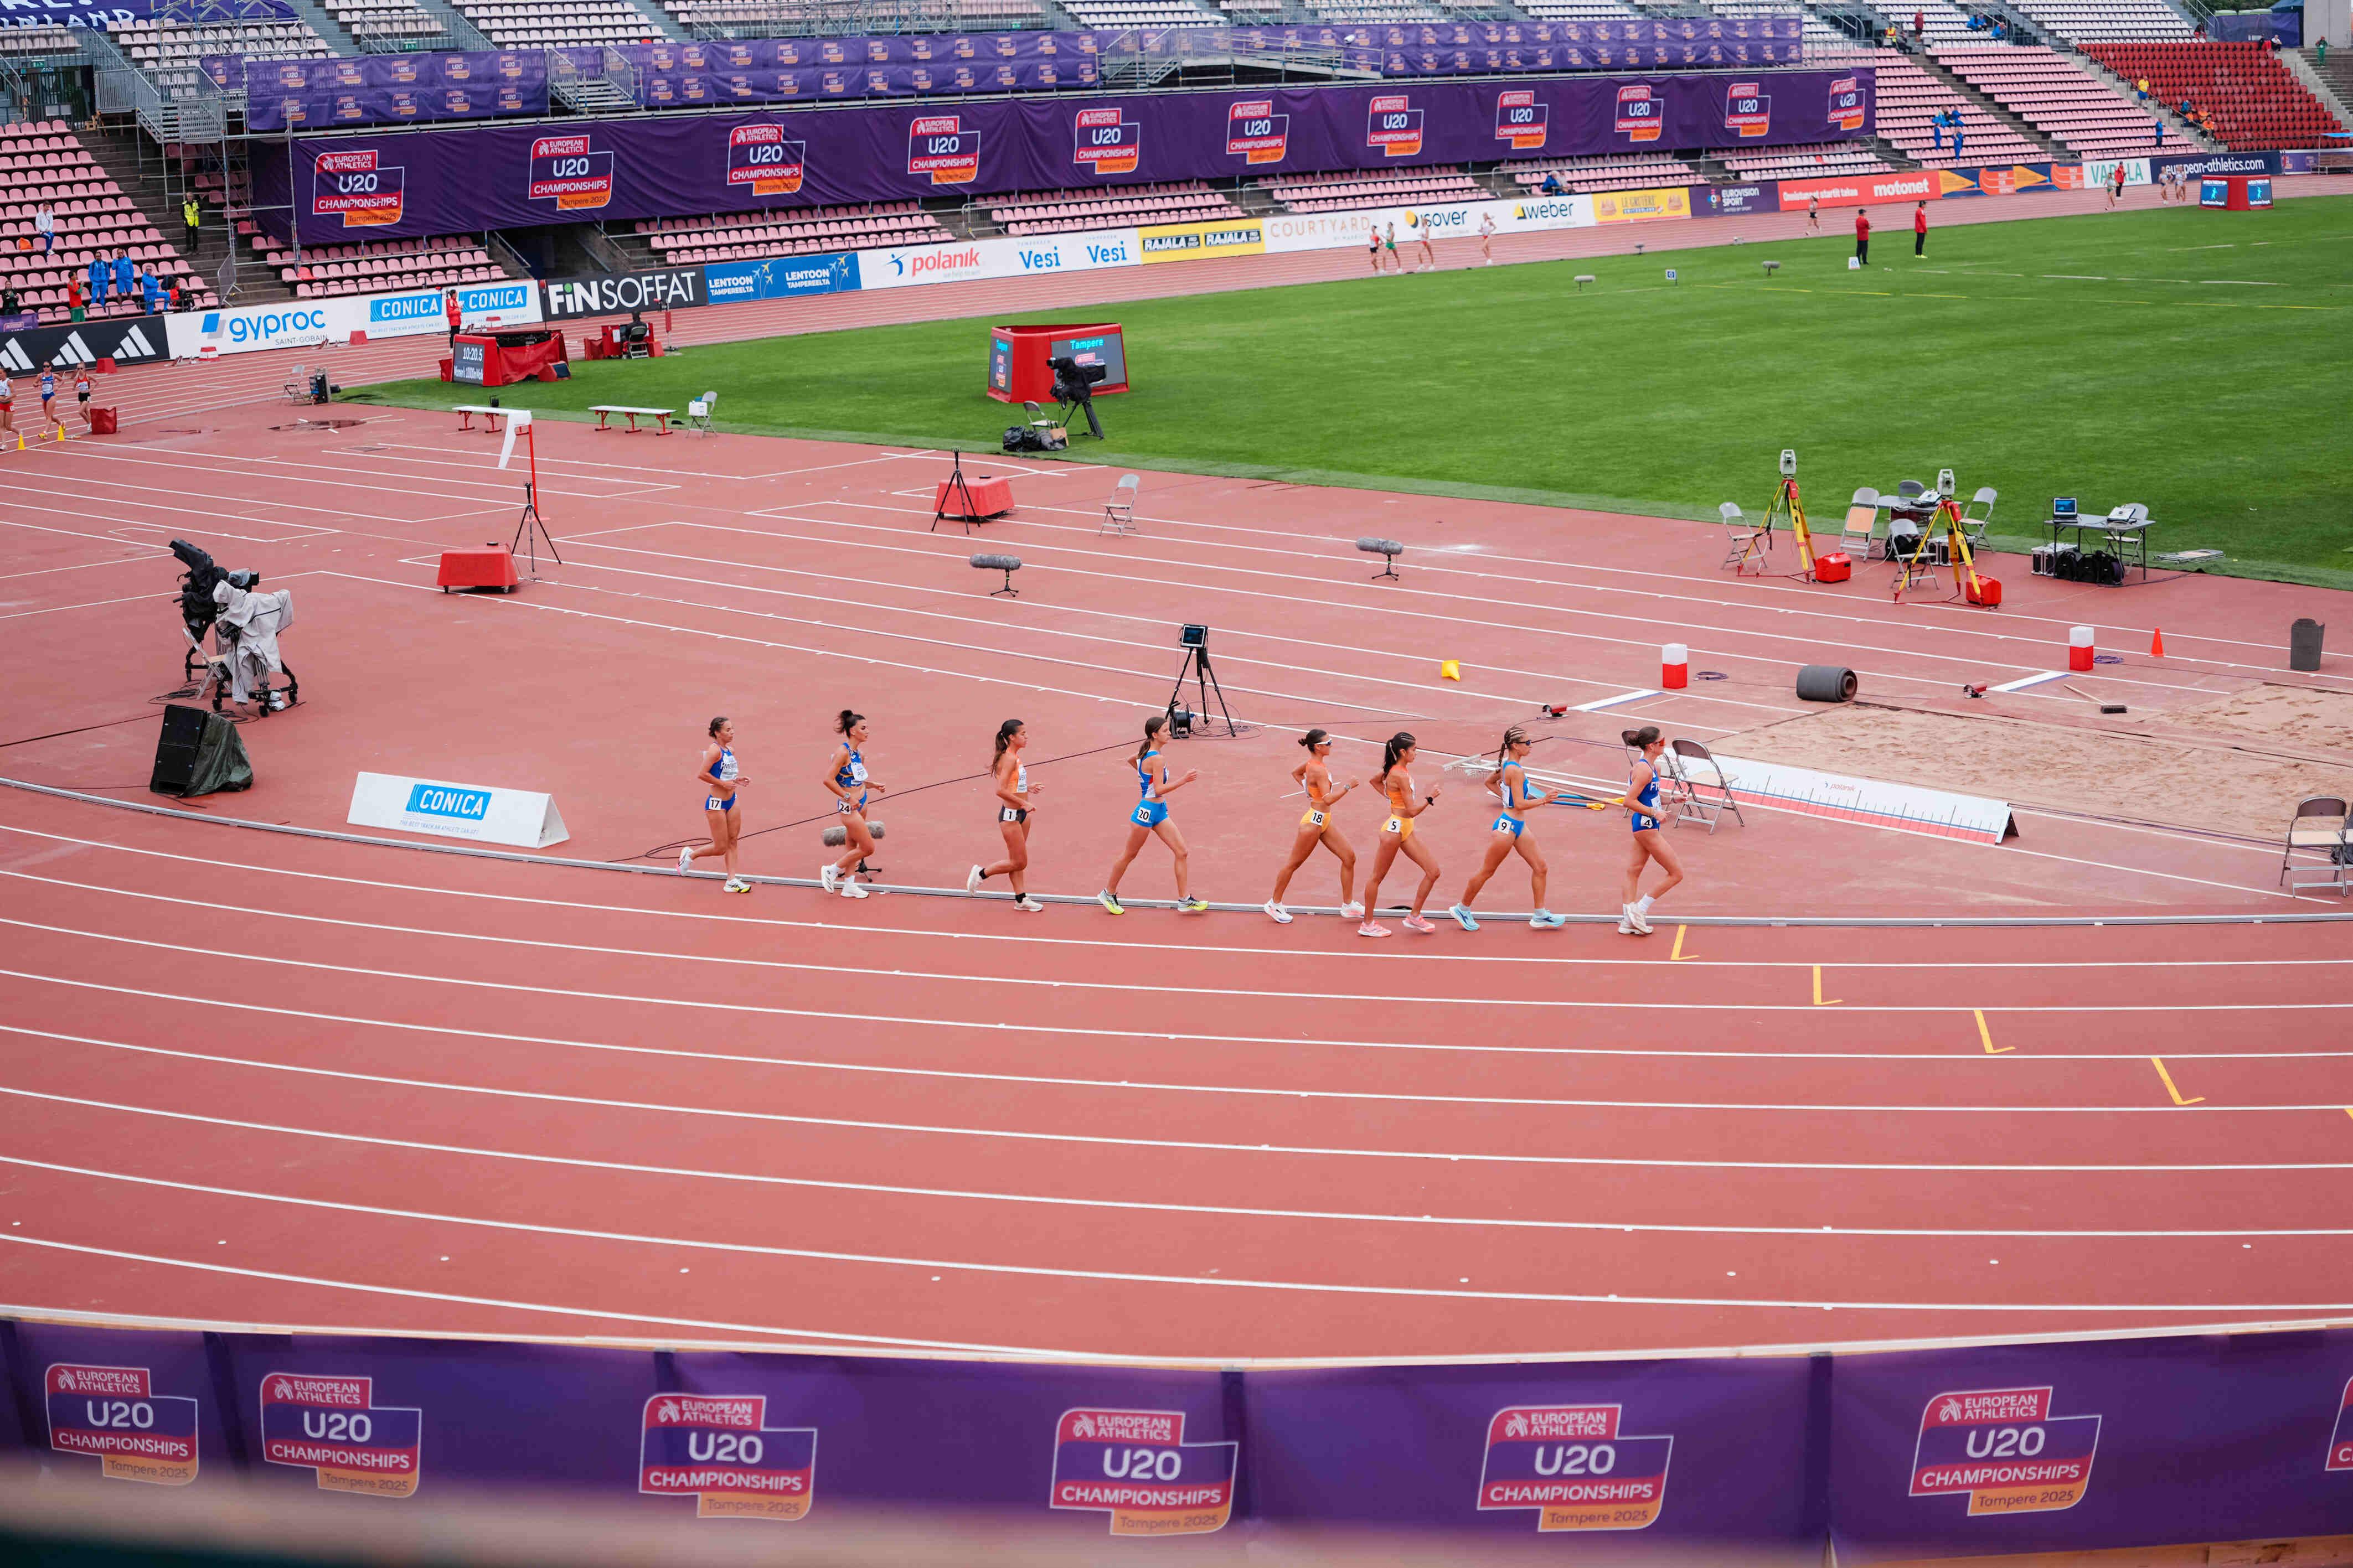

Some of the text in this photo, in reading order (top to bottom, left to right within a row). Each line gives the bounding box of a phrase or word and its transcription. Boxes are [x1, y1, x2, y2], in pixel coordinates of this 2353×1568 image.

[1738, 99, 1757, 113] U20
[1840, 92, 1855, 107] U20
[1510, 108, 1532, 123] U20
[1629, 102, 1650, 116] U20
[1830, 108, 1862, 119] CHAMPIONSHIPS
[1384, 113, 1407, 128] U20
[1618, 119, 1659, 129] CHAMPIONSHIPS
[1728, 115, 1767, 125] CHAMPIONSHIPS
[925, 125, 954, 133] ATHLETICS
[1245, 120, 1271, 136] U20
[1499, 126, 1544, 136] CHAMPIONSHIPS
[747, 133, 777, 141] ATHLETICS
[1092, 128, 1121, 144] U20
[1371, 132, 1418, 142] CHAMPIONSHIPS
[550, 139, 583, 148] EUROPEAN
[550, 144, 584, 154] ATHLETICS
[928, 137, 959, 154] U20
[1230, 138, 1283, 149] CHAMPIONSHIPS
[335, 154, 371, 164] EUROPEAN
[750, 146, 783, 163] U20
[1079, 148, 1134, 159] CHAMPIONSHIPS
[336, 160, 372, 169] ATHLETICS
[553, 158, 589, 177] U20
[912, 157, 974, 169] CHAMPIONSHIPS
[2166, 157, 2264, 175] eupean-athletics.com
[732, 168, 799, 179] CHAMPIONSHIPS
[338, 173, 377, 193] U20
[534, 180, 607, 194] CHAMPIONSHIPS
[1874, 178, 1929, 196] motonet
[318, 196, 397, 209] CHAMPIONSHIPS
[561, 197, 587, 206] Tampere
[1723, 196, 1743, 206] SPORT
[1526, 200, 1573, 219] weber
[1271, 217, 1369, 237] COURTYARD
[1144, 237, 1186, 251] RAJALA
[1206, 232, 1248, 245] RAJALA
[1019, 246, 1060, 268] Vesi
[1087, 241, 1127, 263] Vesi
[912, 247, 979, 276] polanik
[709, 276, 753, 288] LENTOON
[786, 269, 829, 281] LENTOON
[787, 279, 830, 288] TAMPEREELTA
[710, 286, 754, 296] TAMPEREELTA
[469, 291, 523, 308] CONICA
[381, 298, 438, 317] CONICA
[230, 310, 325, 342] gyproc
[275, 334, 328, 346] SAINT-GOBAIN
[1071, 338, 1103, 350] Tampere
[463, 347, 482, 361] 10:20.5
[420, 789, 484, 815] CONICA
[840, 803, 850, 813] 24
[1009, 810, 1012, 819] 1
[1139, 810, 1149, 820] 20
[1313, 813, 1322, 823] 18
[1391, 821, 1396, 830] 5
[1501, 822, 1507, 830] 9
[76, 1370, 139, 1384] EUROPEAN
[79, 1379, 140, 1394] ATHLETICS
[295, 1381, 359, 1394] EUROPEAN
[296, 1390, 360, 1404] ATHLETICS
[1965, 1395, 2037, 1409] EUROPEAN
[86, 1400, 153, 1428] U20
[682, 1401, 752, 1414] EUROPEAN
[1964, 1406, 2037, 1420] ATHLETICS
[682, 1412, 752, 1426] ATHLETICS
[1098, 1415, 1171, 1429] EUROPEAN
[1531, 1412, 1606, 1425] EUROPEAN
[303, 1411, 371, 1442] U20
[1098, 1427, 1171, 1440] ATHLETICS
[1531, 1424, 1606, 1436] ATHLETICS
[59, 1433, 188, 1457] CHAMPIONSHIPS
[689, 1432, 763, 1464] U20
[1966, 1427, 2045, 1457] U20
[272, 1444, 409, 1469] CHAMPIONSHIPS
[1534, 1445, 1616, 1476] U20
[110, 1460, 188, 1478] Tampere 2025
[1103, 1448, 1181, 1481] U20
[324, 1473, 408, 1491] Tampere 2025
[649, 1472, 802, 1491] CHAMPIONSHIPS
[1922, 1464, 2080, 1487] CHAMPIONSHIPS
[1062, 1486, 1221, 1505] CHAMPIONSHIPS
[1490, 1484, 1653, 1502] CHAMPIONSHIPS
[1979, 1491, 2074, 1509] Tampere 2025
[706, 1499, 799, 1513] Tampere 2025
[1121, 1515, 1218, 1529] Tampere 2025
[1550, 1511, 1648, 1525] Tampere 2025
